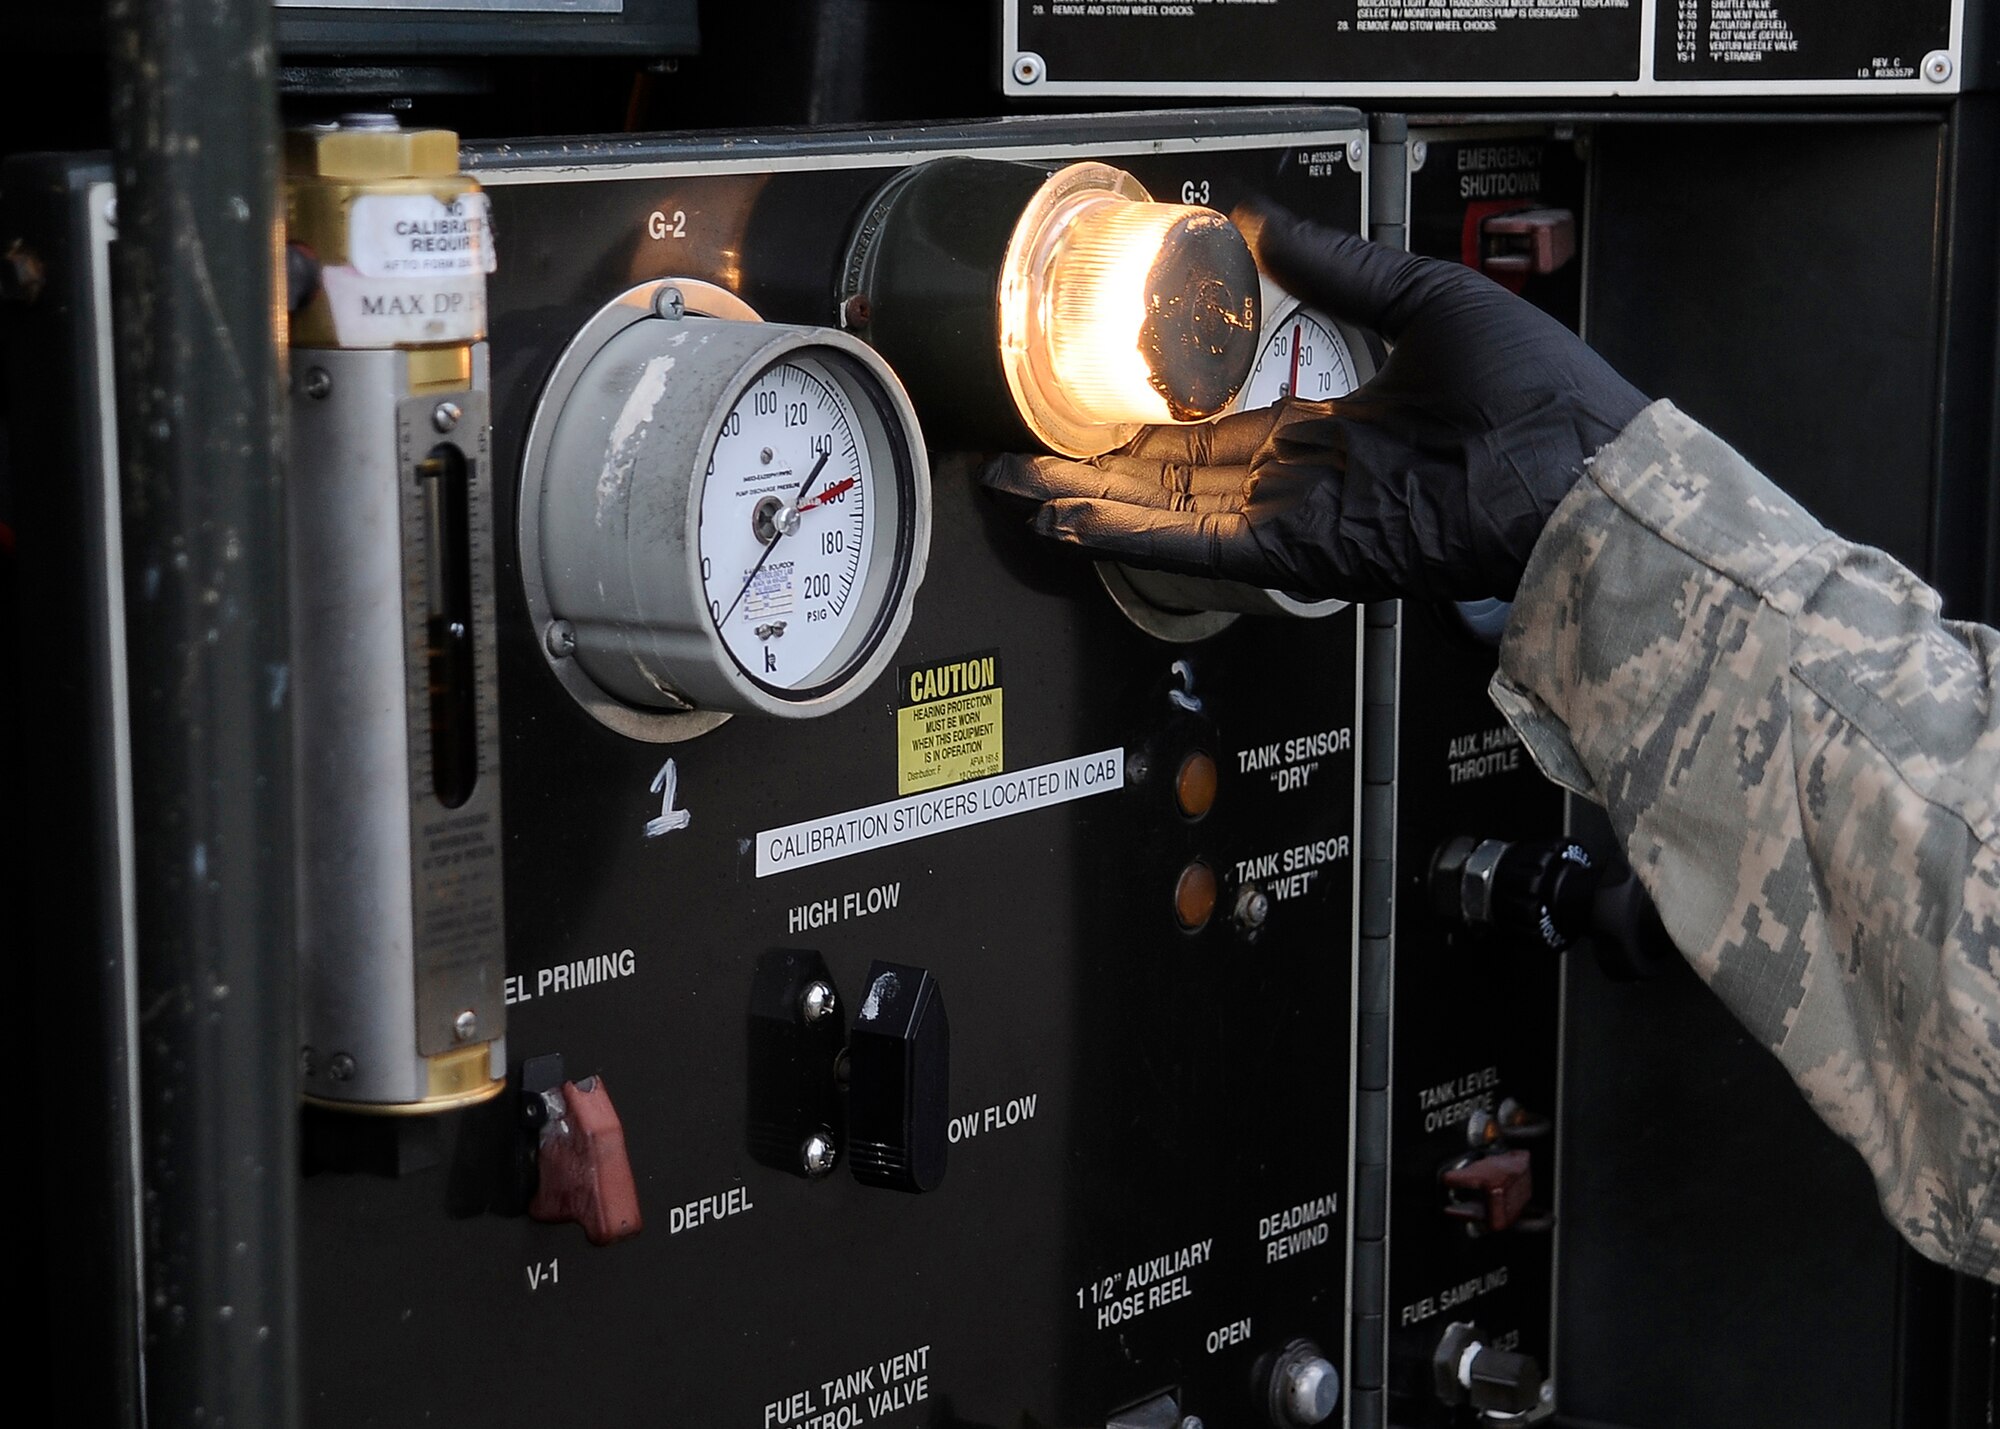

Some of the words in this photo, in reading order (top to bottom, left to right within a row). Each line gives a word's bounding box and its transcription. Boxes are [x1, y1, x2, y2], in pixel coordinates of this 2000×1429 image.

[1052, 5, 1086, 15] REMOVE
[1087, 6, 1104, 15] AND
[1106, 6, 1130, 15] STOW
[1131, 6, 1158, 16] WHEEL
[1404, 8, 1441, 18] MONITOR
[1452, 8, 1493, 18] INDICATES
[1494, 8, 1518, 18] PUMP
[1518, 8, 1527, 18] IS
[1712, 10, 1732, 19] TANK
[1733, 10, 1753, 19] VENT
[1754, 10, 1778, 18] VALVE
[1356, 20, 1390, 31] REMOVE
[1391, 20, 1409, 30] AND
[1410, 20, 1434, 30] STOW
[1434, 20, 1462, 31] WHEEL
[1710, 20, 1751, 30] ACTUATOR
[1733, 30, 1756, 40] VALVE
[1724, 52, 1762, 62] STRAINER
[1774, 40, 1798, 51] VALVE
[1457, 146, 1543, 171] EMERGENCY
[1182, 180, 1210, 204] G-3
[1460, 172, 1540, 198] SHUTDOWN
[648, 210, 686, 240] G-2
[361, 294, 424, 316] MAX
[1274, 336, 1288, 358] 50
[1299, 346, 1312, 366] 60
[1318, 372, 1331, 392] 70
[754, 390, 778, 416] 100
[784, 402, 808, 427] 120
[810, 434, 832, 460] 140
[821, 530, 844, 555] 180
[804, 573, 831, 600] 200
[806, 609, 828, 622] PSIG
[910, 656, 994, 702] CAUTION
[1168, 660, 1202, 712] 2
[913, 703, 946, 722] HEARING
[946, 694, 992, 714] PROTECTION
[926, 719, 946, 734] MUST
[947, 716, 957, 728] BE
[959, 710, 981, 727] WORN
[912, 736, 936, 752] WHEN
[936, 732, 952, 746] THIS
[952, 722, 994, 743] EQUIPMENT
[1238, 743, 1280, 774] TANK
[1283, 727, 1350, 763] SENSOR
[924, 751, 932, 764] IS
[933, 748, 941, 762] IN
[941, 740, 983, 760] OPERATION
[1448, 748, 1520, 784] THROTTLE
[644, 757, 692, 838] 1
[770, 813, 888, 862] CALIBRATION
[893, 791, 978, 832] STICKERS
[983, 772, 1060, 811] LOCATED
[1064, 767, 1079, 790] IN
[1084, 758, 1116, 786] CAB
[1236, 852, 1280, 884] TANK
[1282, 835, 1350, 872] SENSOR
[788, 898, 838, 934] HIGH
[843, 882, 901, 921] FLOW
[504, 976, 532, 1004] EL
[538, 949, 636, 996] PRIMING
[1418, 1080, 1456, 1110] TANK
[1458, 1066, 1501, 1096] LEVEL
[948, 1112, 980, 1144] OW
[984, 1094, 1038, 1132] FLOW
[670, 1186, 754, 1234] DEFUEL
[1258, 1192, 1338, 1241] DEADMAN
[1266, 1222, 1329, 1264] REWIND
[526, 1258, 559, 1290] V-1
[1076, 1288, 1084, 1310] 1
[1125, 1238, 1212, 1292] AUXILIARY
[1098, 1292, 1145, 1330] HOSE
[1149, 1276, 1192, 1310] REEL
[1402, 1296, 1438, 1328] FUEL
[1440, 1266, 1508, 1312] SAMPLING
[1206, 1318, 1250, 1354] OPEN
[764, 1390, 816, 1429] FUEL
[821, 1366, 874, 1406] TANK
[880, 1345, 930, 1385] VENT
[868, 1375, 929, 1418] VALVE
